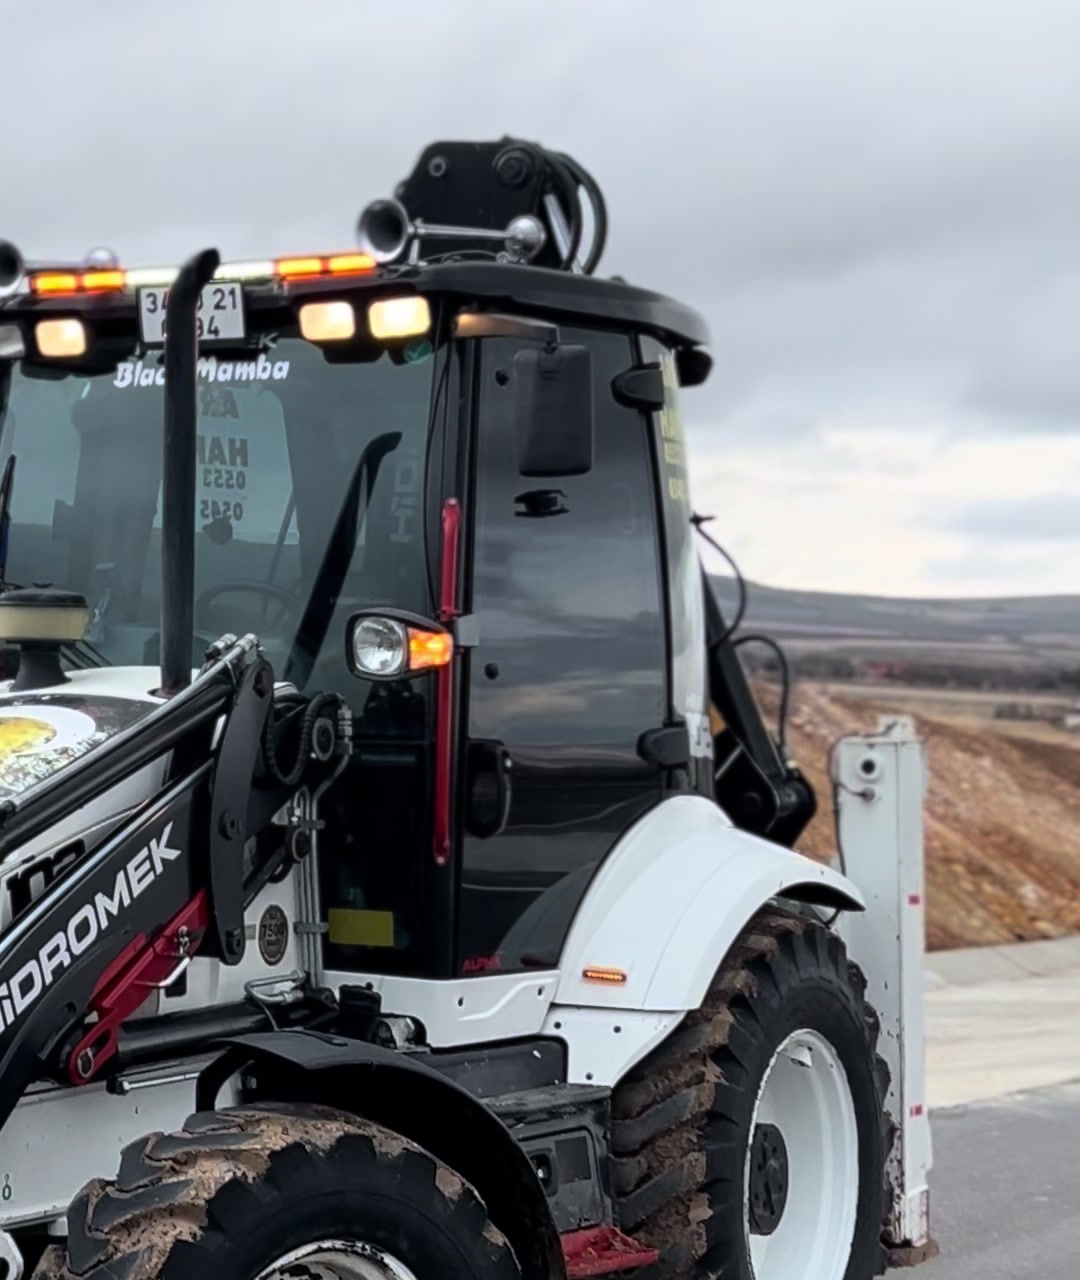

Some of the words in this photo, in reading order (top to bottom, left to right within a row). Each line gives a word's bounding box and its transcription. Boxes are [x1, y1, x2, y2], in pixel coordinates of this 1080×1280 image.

[213, 287, 238, 310] 21
[113, 362, 166, 389] Blac
[196, 355, 290, 383] Mamba
